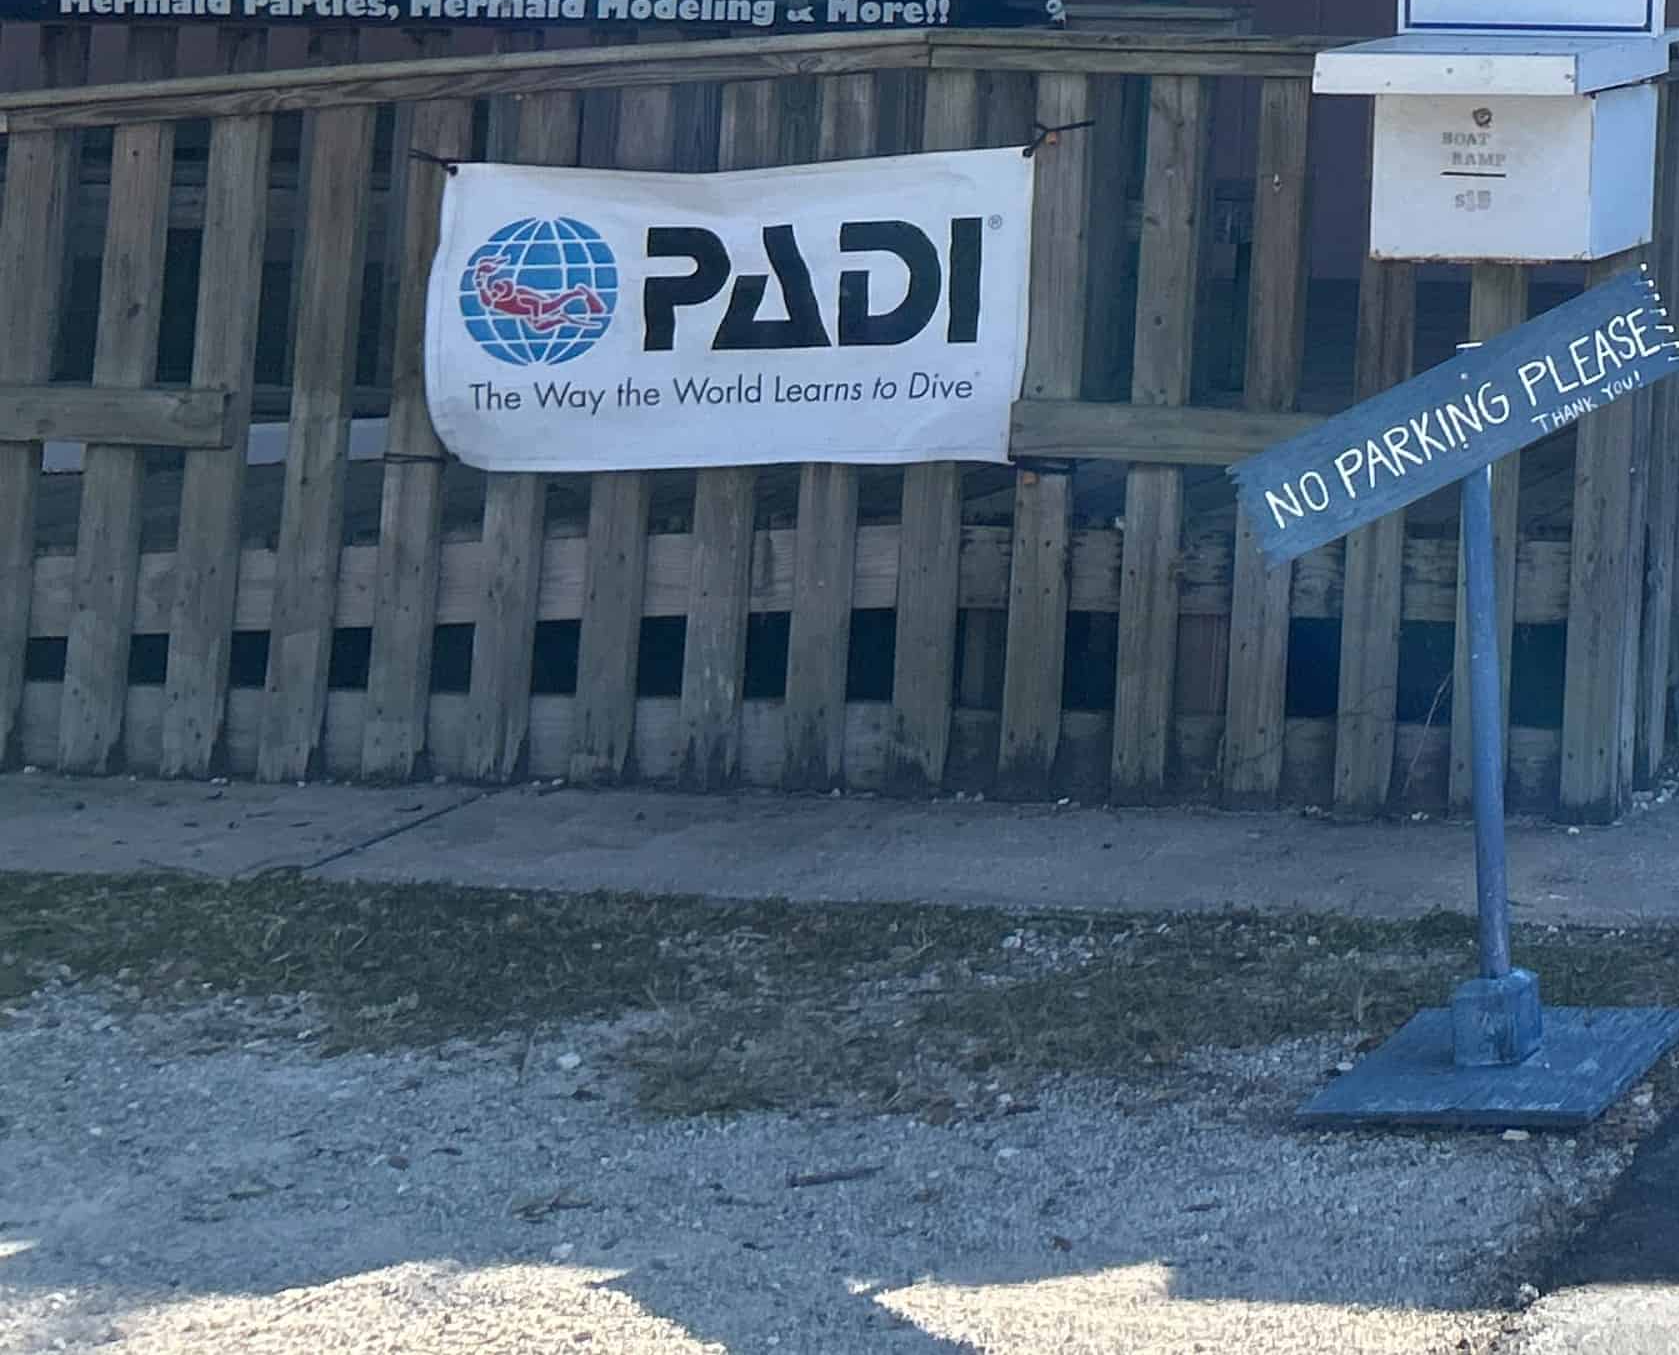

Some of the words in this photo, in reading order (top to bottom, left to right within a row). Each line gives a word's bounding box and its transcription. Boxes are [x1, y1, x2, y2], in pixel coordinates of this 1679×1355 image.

[1441, 131, 1491, 146] BOAT
[1451, 151, 1506, 166] RAMP
[643, 217, 984, 352] PADI
[469, 382, 522, 412] The
[533, 381, 607, 416] Way
[616, 378, 661, 408] the
[673, 374, 763, 406] World
[774, 373, 863, 403] Learns
[872, 375, 897, 401] to
[907, 371, 974, 399] Dive
[1264, 470, 1330, 530] NO
[1333, 381, 1511, 500] PARKING
[1517, 307, 1664, 407] PLEASE
[1530, 399, 1599, 435] THANK
[1600, 369, 1644, 403] YOU!
